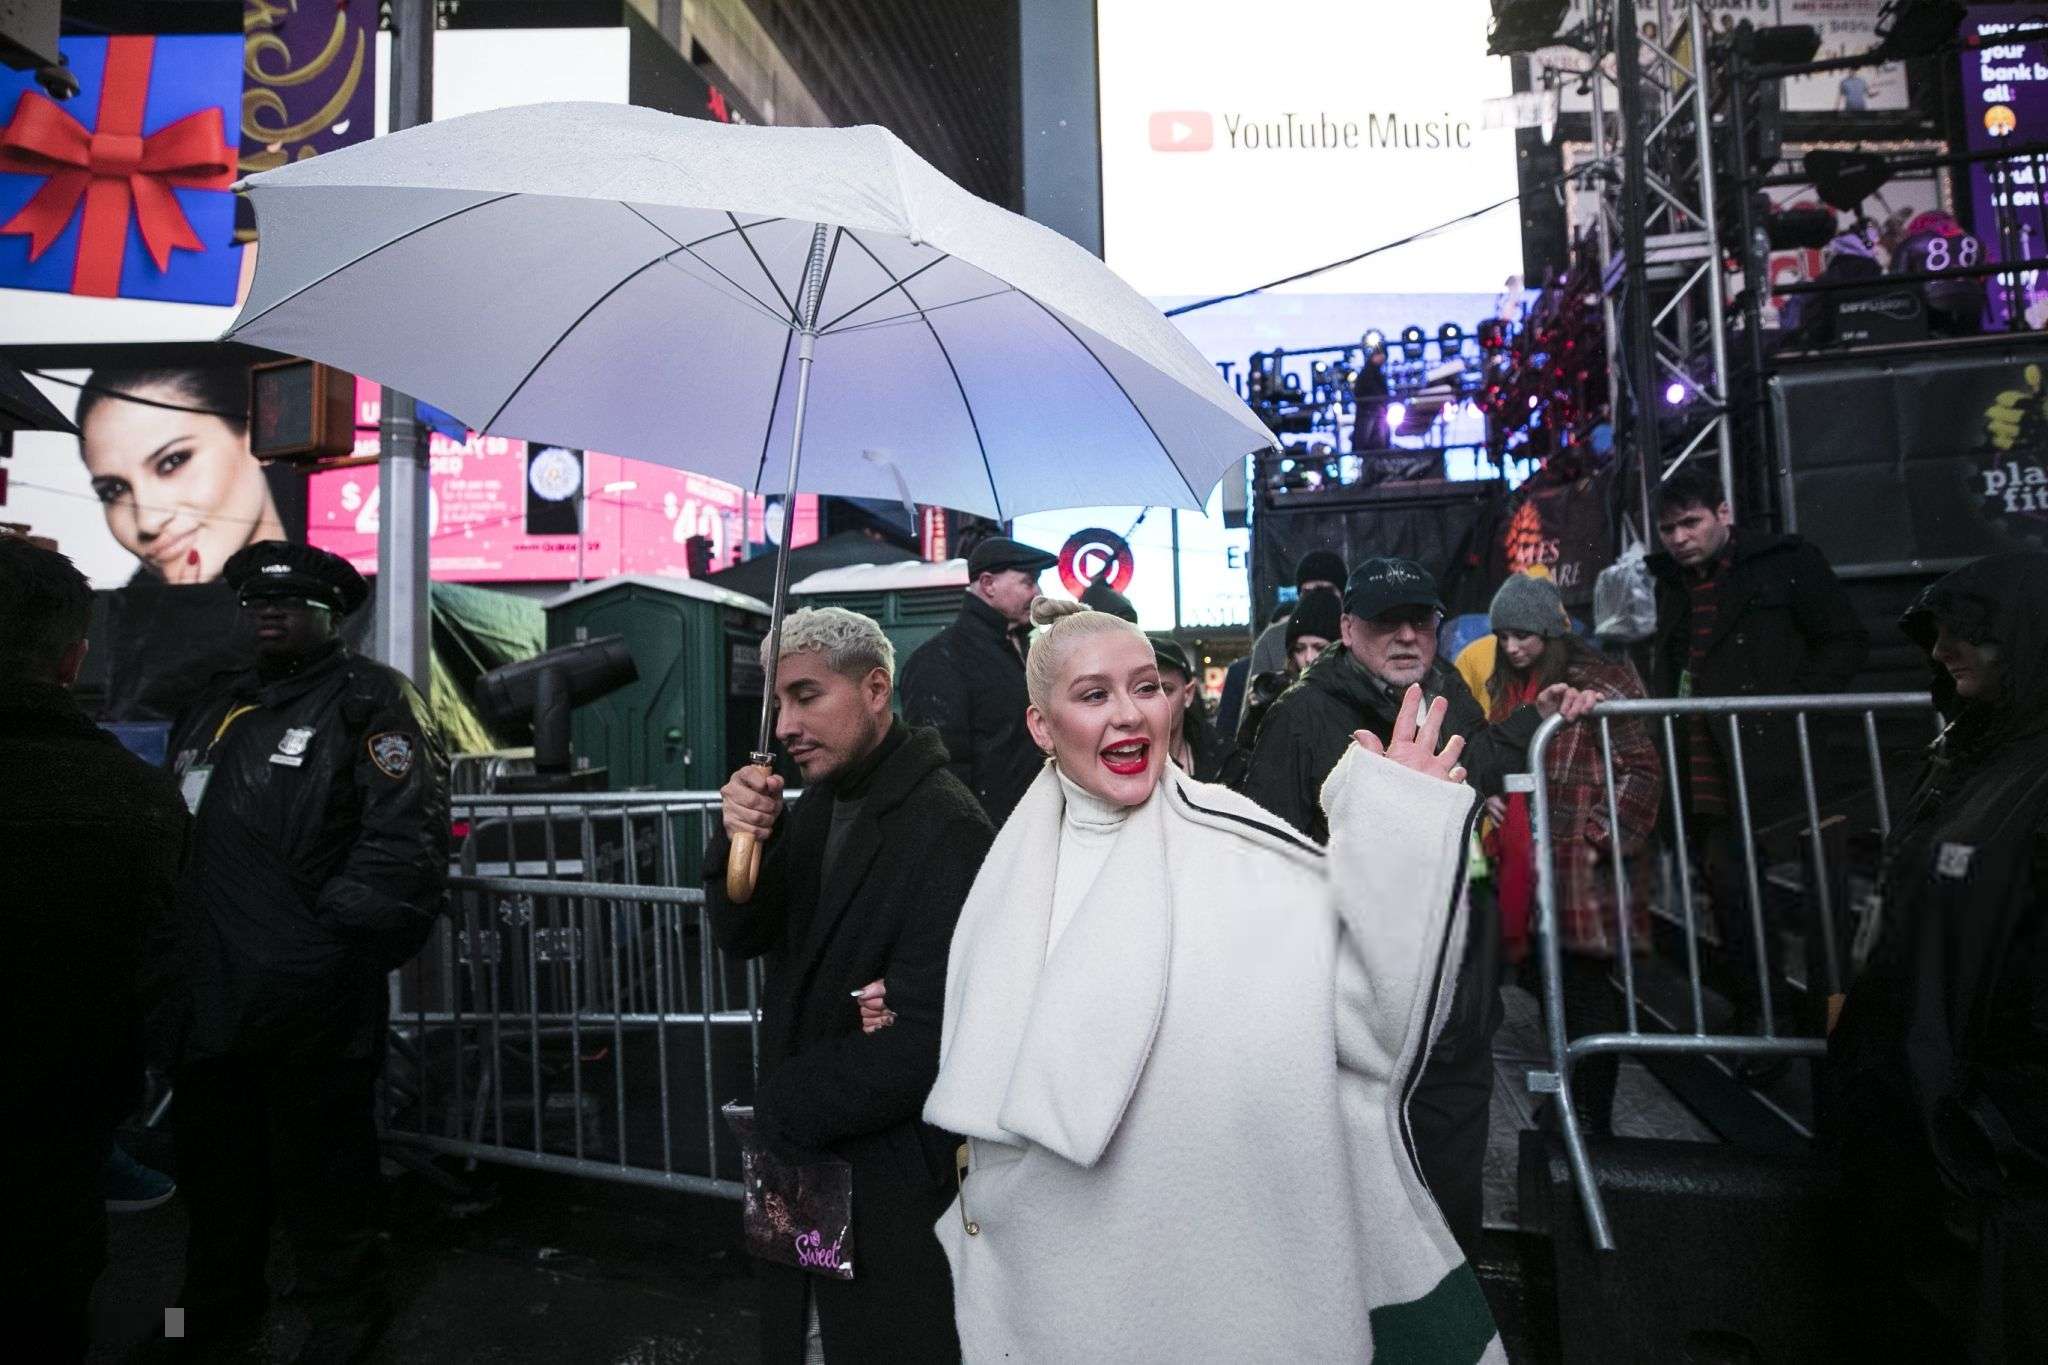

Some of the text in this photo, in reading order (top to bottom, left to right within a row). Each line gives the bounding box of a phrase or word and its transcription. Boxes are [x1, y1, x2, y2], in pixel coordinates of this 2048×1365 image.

[1980, 45, 2026, 63] your
[1981, 62, 2032, 82] bank
[1224, 112, 1472, 149] YouTube Music
